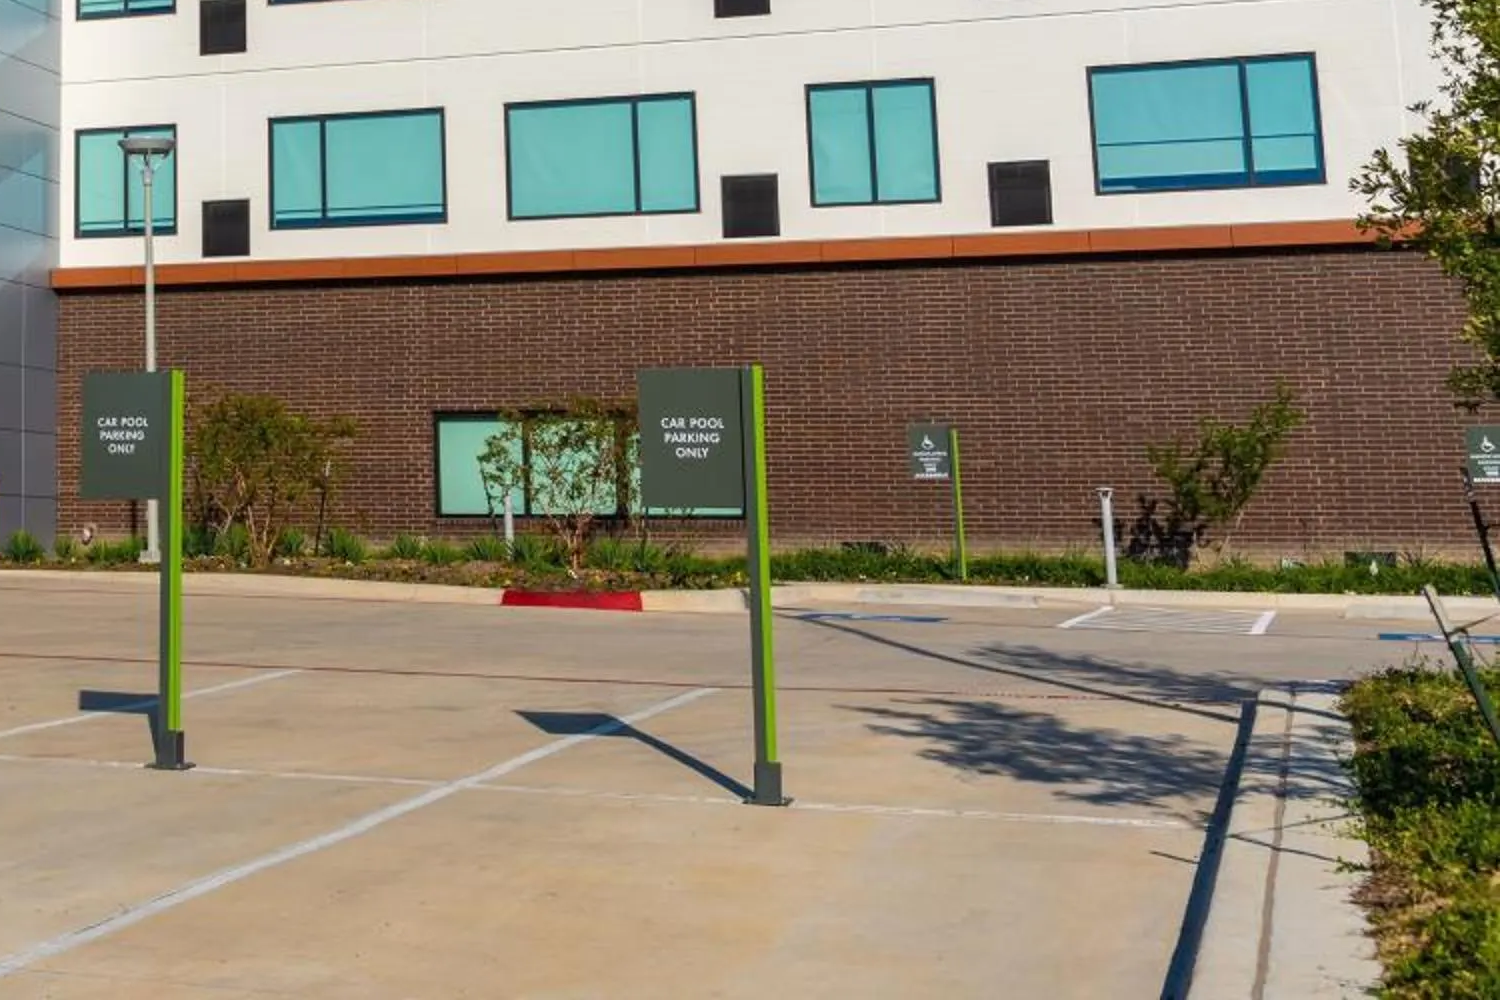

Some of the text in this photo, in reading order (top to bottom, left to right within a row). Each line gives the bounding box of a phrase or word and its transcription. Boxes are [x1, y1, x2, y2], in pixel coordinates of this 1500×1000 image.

[97, 417, 149, 427] CAR POOL
[661, 417, 725, 429] CAR POOL
[100, 430, 145, 441] PARKING
[664, 432, 721, 443] PARKING
[108, 443, 136, 454] ONLY
[676, 447, 709, 459] ONLY
